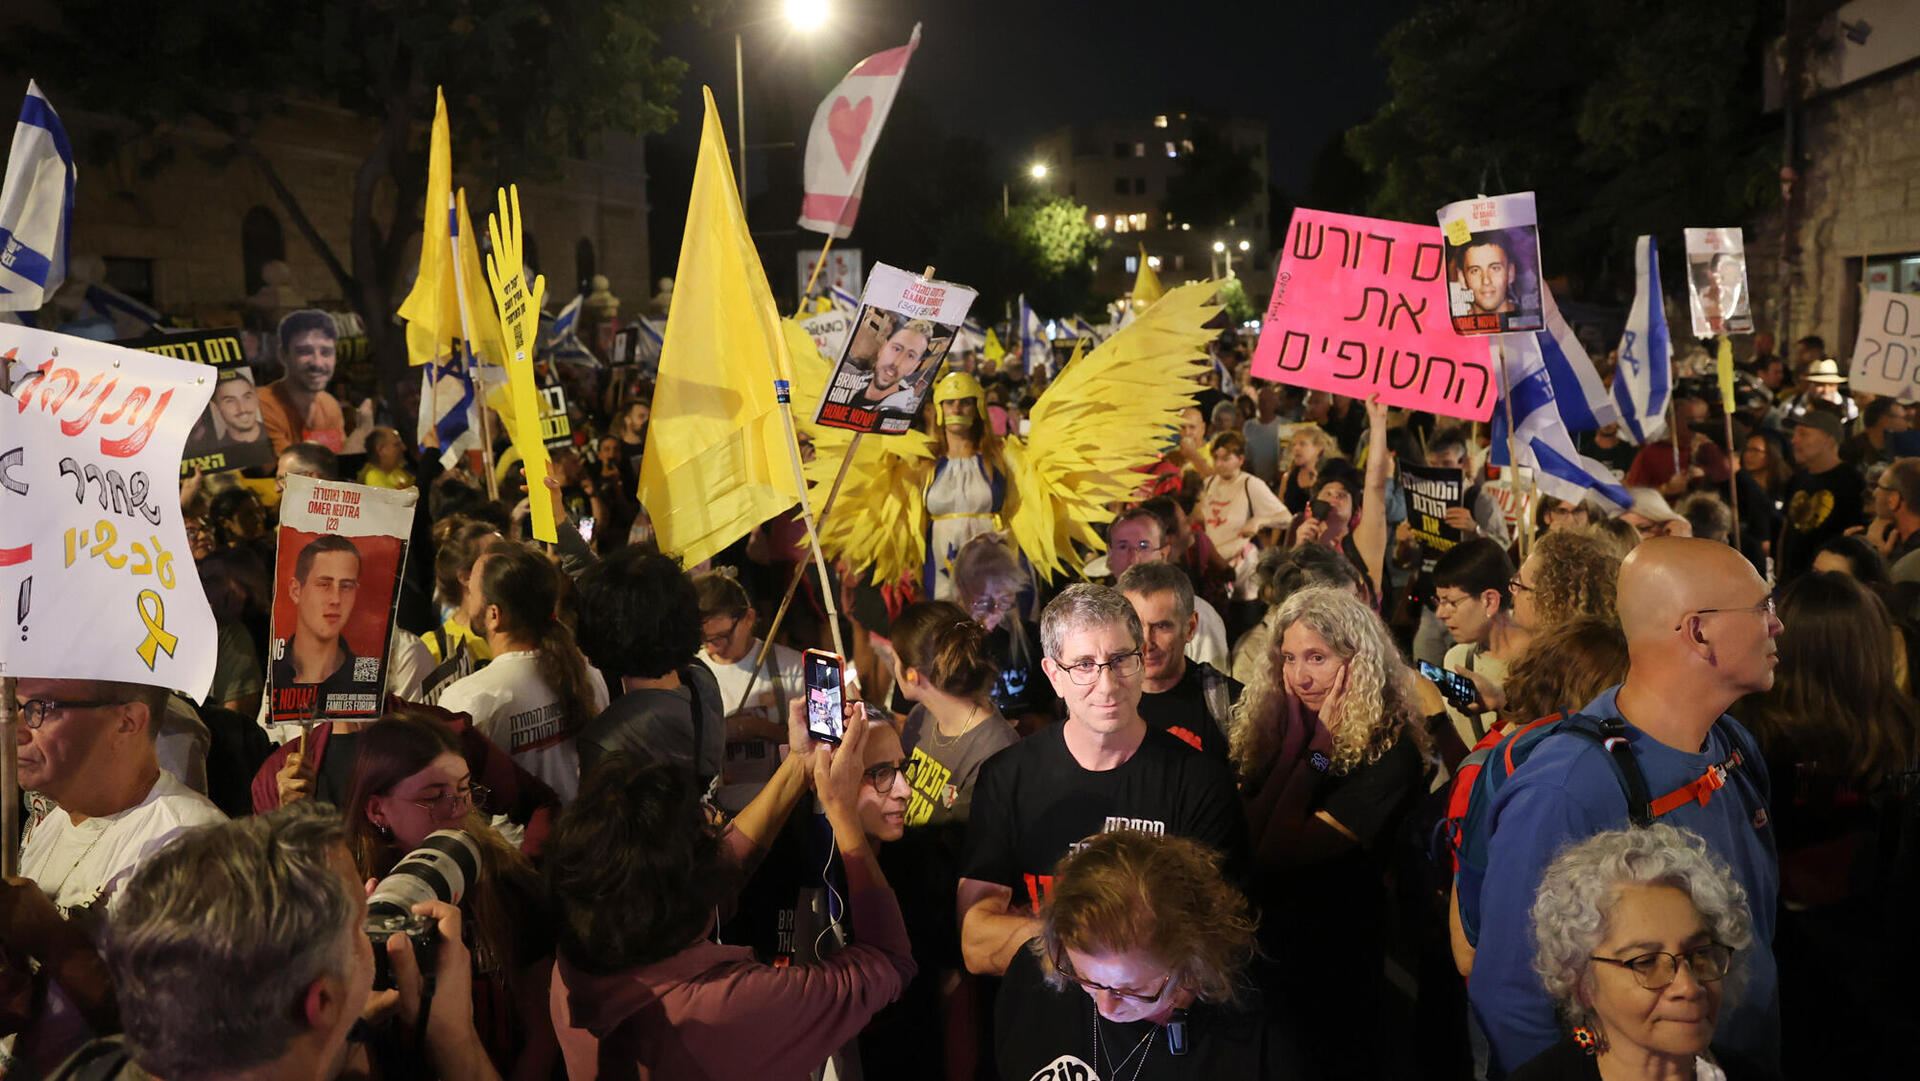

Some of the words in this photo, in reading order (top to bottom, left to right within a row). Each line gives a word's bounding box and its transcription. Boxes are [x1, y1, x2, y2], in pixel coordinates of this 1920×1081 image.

[1293, 221, 1396, 275] דורש
[1343, 286, 1428, 334] את
[204, 336, 243, 364] רום
[834, 372, 867, 391] BRING
[1277, 330, 1489, 409] החטופים
[828, 387, 850, 404] HIM
[822, 403, 851, 421] HOME
[848, 408, 879, 427] NOW!
[58, 457, 161, 526] שחרר
[342, 489, 361, 505] עומר
[307, 500, 331, 516] OMER
[332, 503, 360, 519] NEUTRA
[326, 516, 339, 532] (22)
[1422, 514, 1441, 536] את
[63, 519, 176, 590] עכשיו
[279, 684, 319, 711] NOW!
[326, 700, 353, 711] FAMILIES
[353, 700, 377, 711] FORUM
